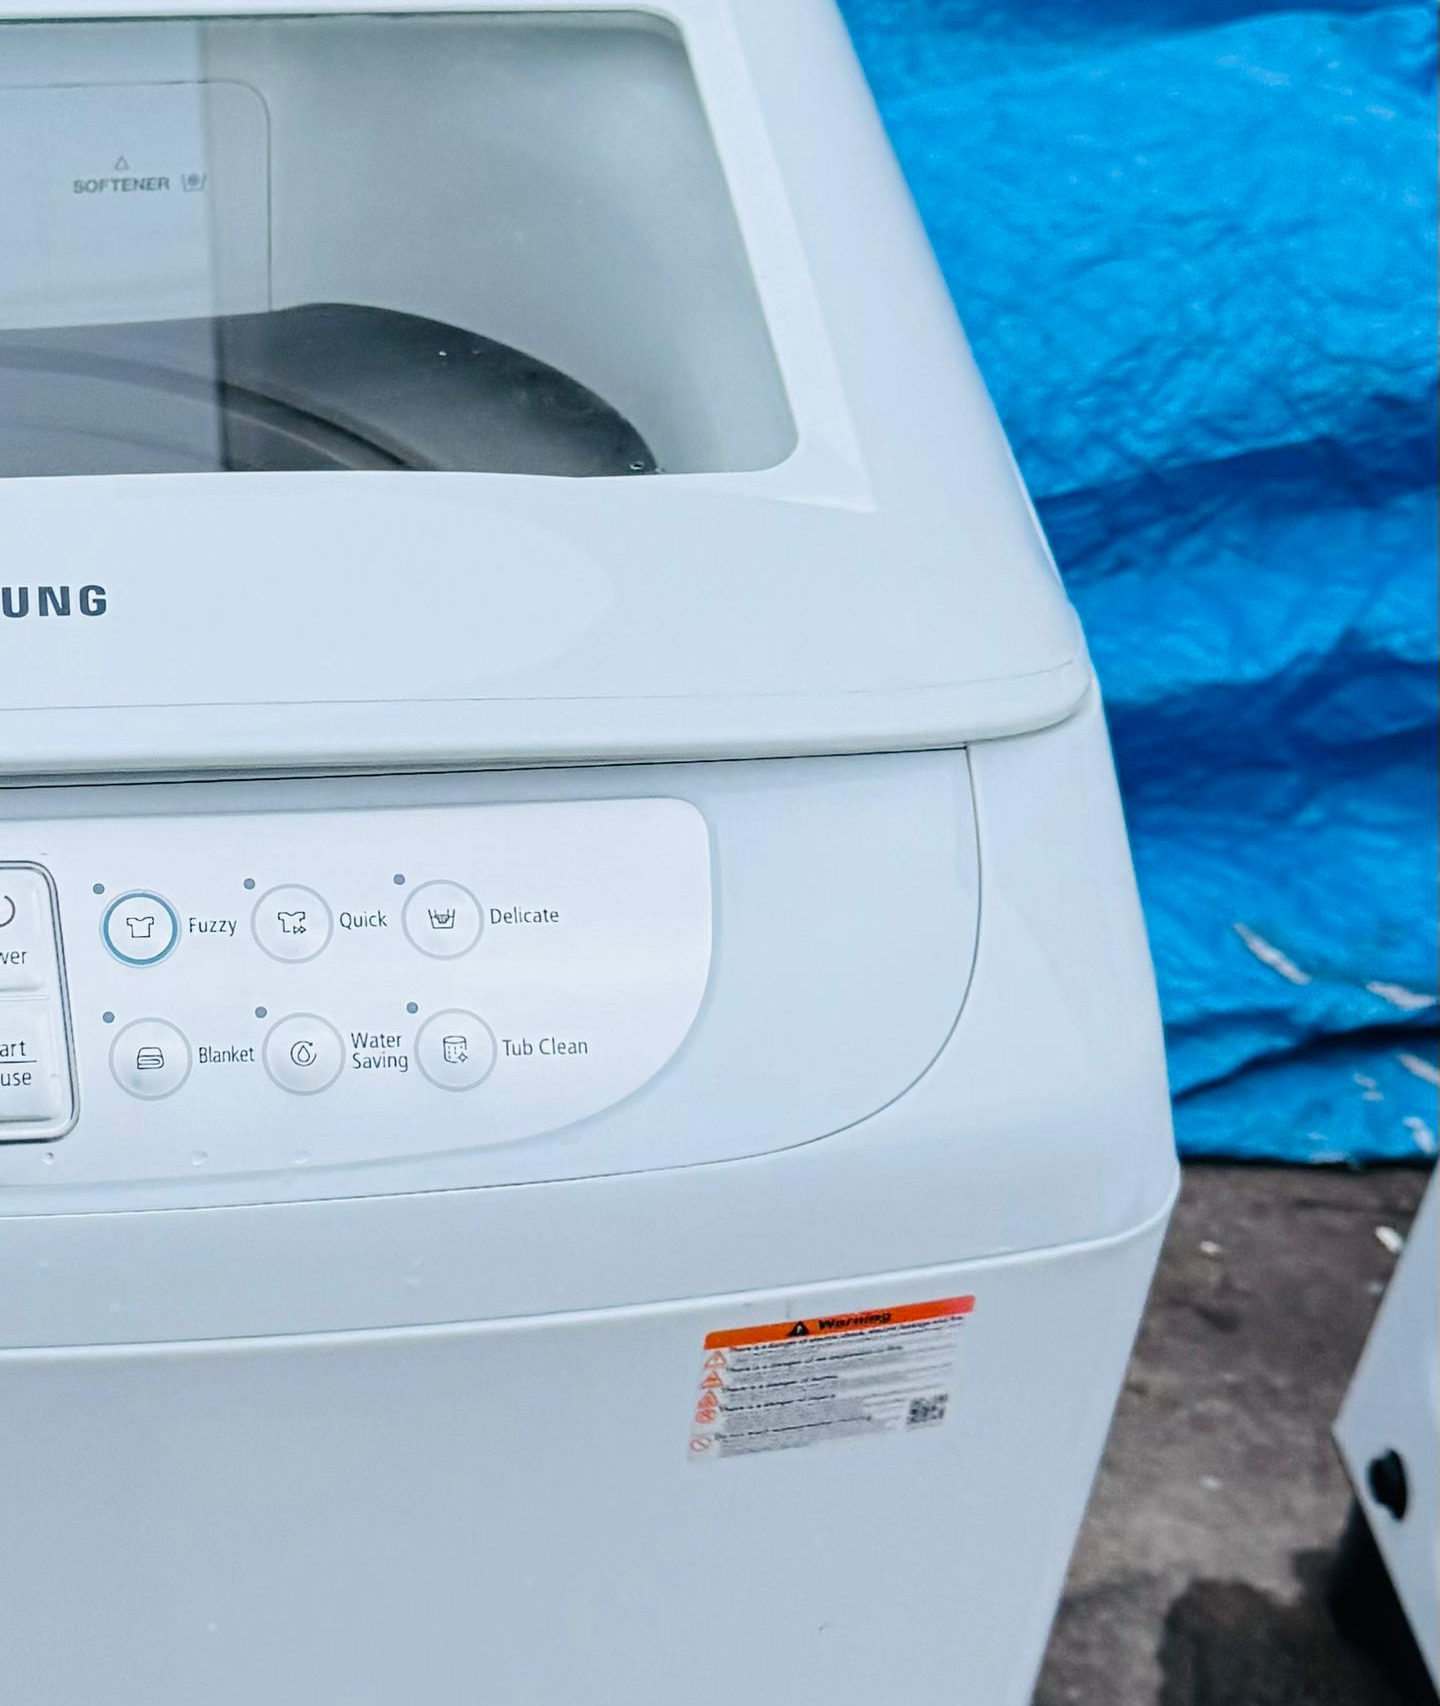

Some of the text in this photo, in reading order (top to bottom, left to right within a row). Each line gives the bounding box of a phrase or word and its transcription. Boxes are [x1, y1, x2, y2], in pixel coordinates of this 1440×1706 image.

[73, 176, 170, 194] SOFTENER
[339, 910, 388, 930] Quick
[490, 906, 560, 925] Delicate
[189, 917, 237, 936] Fuzzy
[350, 1032, 403, 1050] Water
[502, 1037, 589, 1057] Tub Clean
[198, 1045, 255, 1064] Blanket
[352, 1051, 408, 1073] Saving
